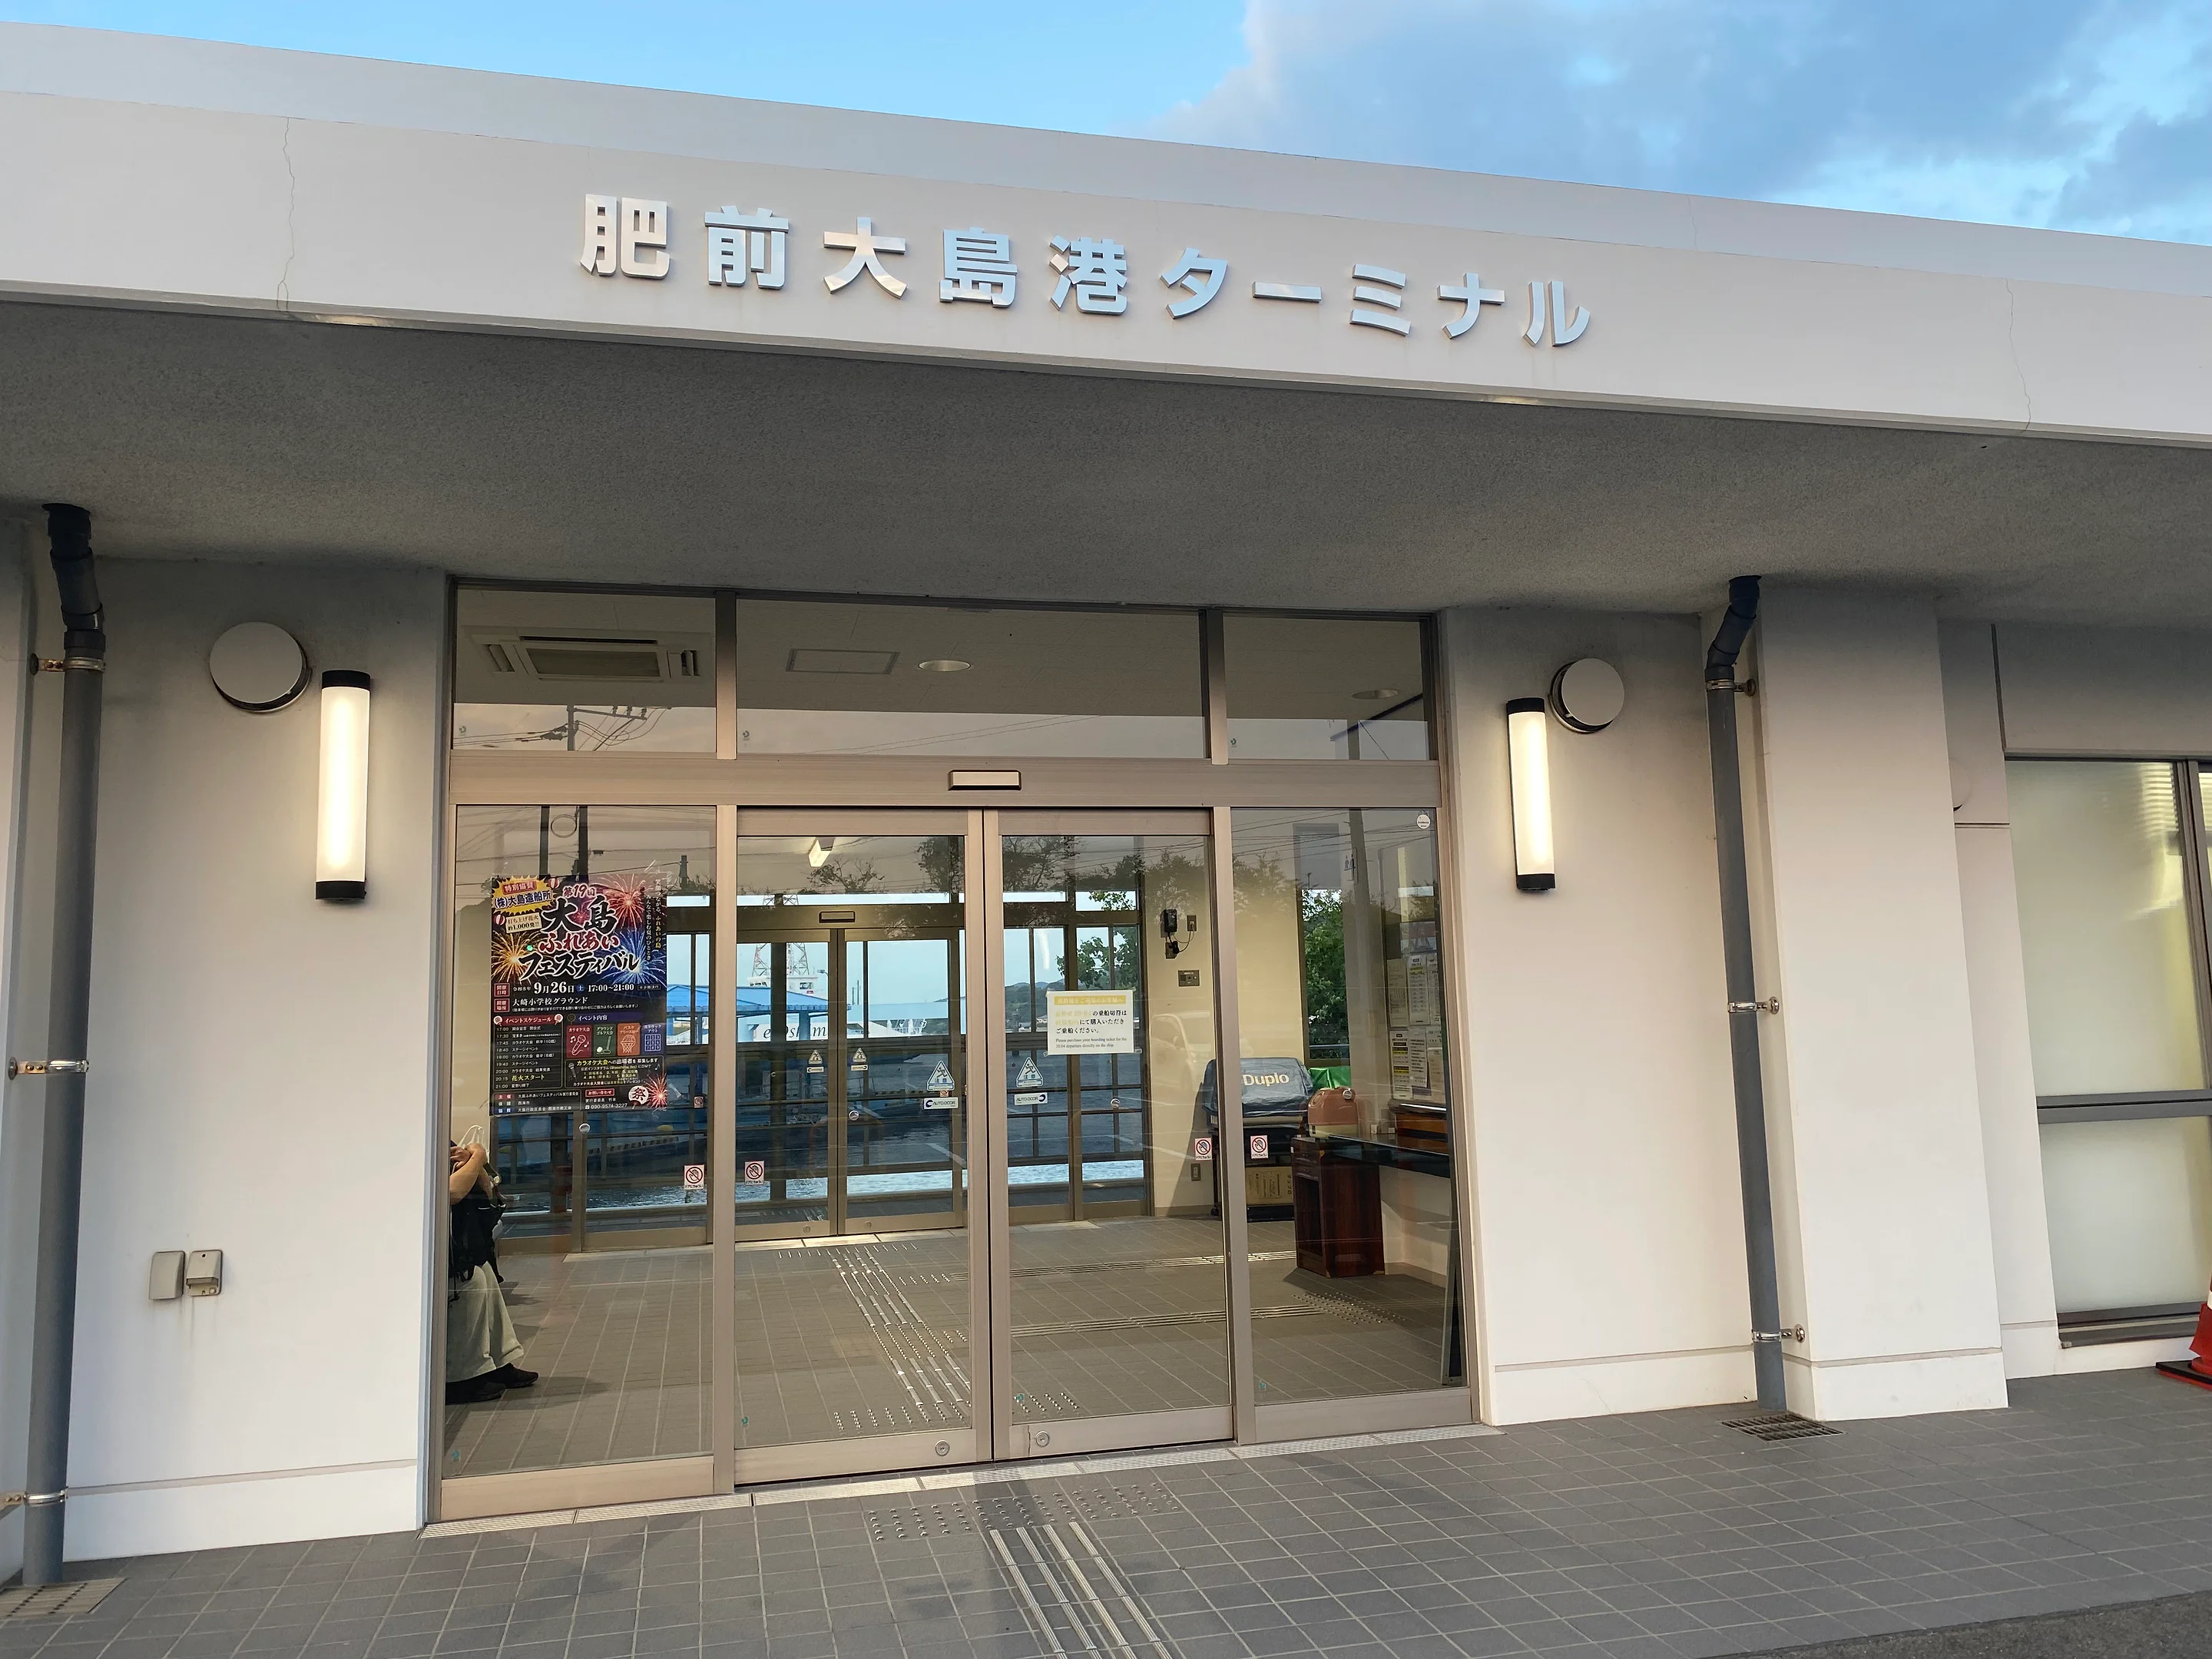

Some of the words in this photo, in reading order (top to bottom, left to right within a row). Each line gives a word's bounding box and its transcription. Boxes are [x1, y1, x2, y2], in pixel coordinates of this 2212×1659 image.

[580, 194, 1591, 347] 肥前大島港ターミナル
[504, 881, 534, 892] 特別協賛
[563, 883, 595, 897] 第19回
[494, 891, 551, 909] (株)大島造船所
[508, 916, 539, 925] 打ち上げ花火
[541, 894, 618, 935] 大島
[538, 930, 620, 953] ふれあい
[518, 951, 641, 980] フェスティバル
[534, 982, 575, 994] 9月26日
[512, 996, 588, 1006] 大崎小学校グラウンド
[1243, 1072, 1290, 1087] Duplo
[632, 1087, 646, 1101] 祭
